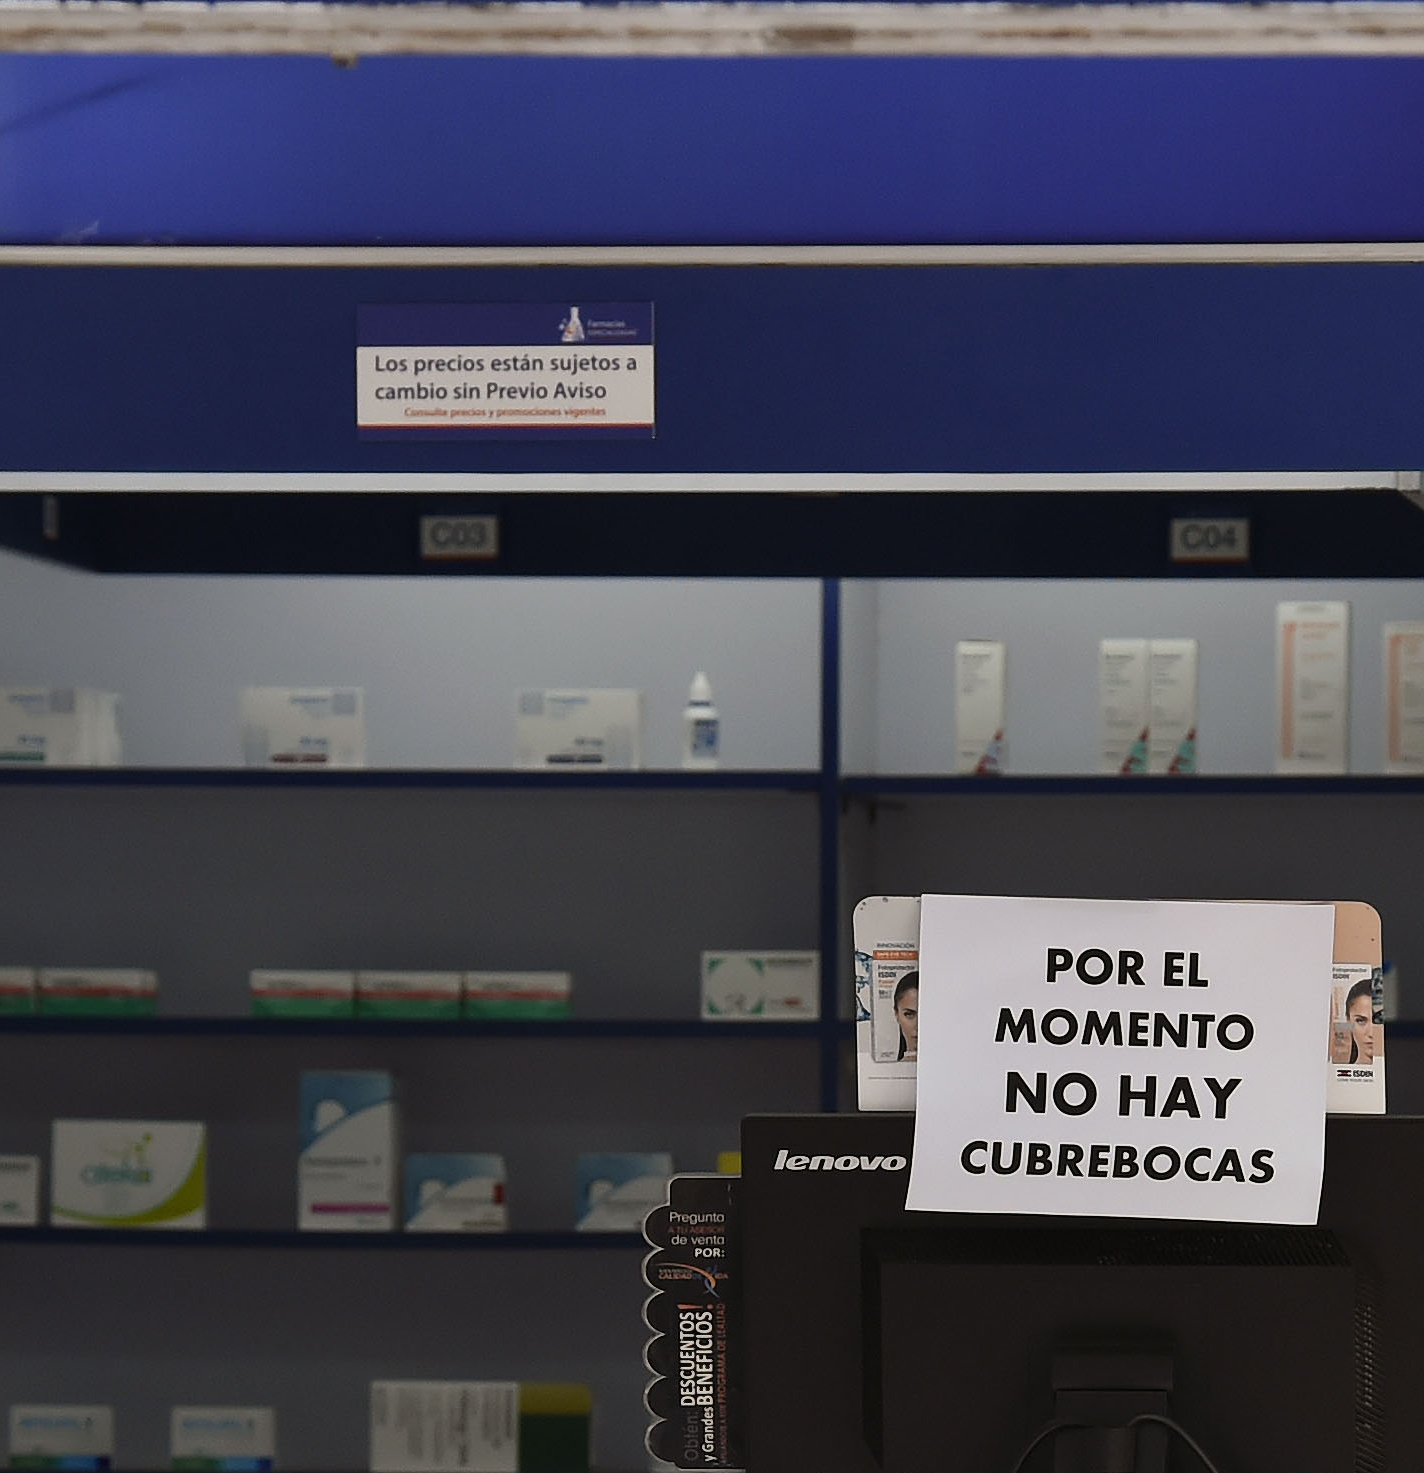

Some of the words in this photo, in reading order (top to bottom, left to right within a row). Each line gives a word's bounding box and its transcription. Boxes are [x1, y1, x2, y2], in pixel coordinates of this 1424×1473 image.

[375, 355, 408, 373] Los
[414, 354, 484, 375] precios
[491, 354, 543, 372] están
[550, 354, 620, 375] sujetos
[626, 357, 637, 371] a
[375, 382, 447, 401] cambio
[453, 381, 480, 400] sin
[486, 381, 548, 400] Previo
[553, 381, 607, 400] Aviso
[1045, 947, 1145, 988] POR
[1162, 950, 1210, 989] EL
[994, 1006, 1255, 1051] MOMENTO
[1004, 1070, 1098, 1116] NO
[1117, 1075, 1243, 1120] HAY
[773, 1148, 908, 1172] lenovo
[959, 1139, 1277, 1184] CUBREBOCAS
[669, 1211, 725, 1224] Pregunta
[671, 1233, 688, 1246] de
[691, 1235, 725, 1246] venta
[694, 1248, 726, 1258] POR:
[679, 1312, 696, 1407] DESCUENTOS
[696, 1311, 713, 1405] BENEFICIOS
[701, 1406, 714, 1453] Grandes
[704, 1453, 716, 1463] y
